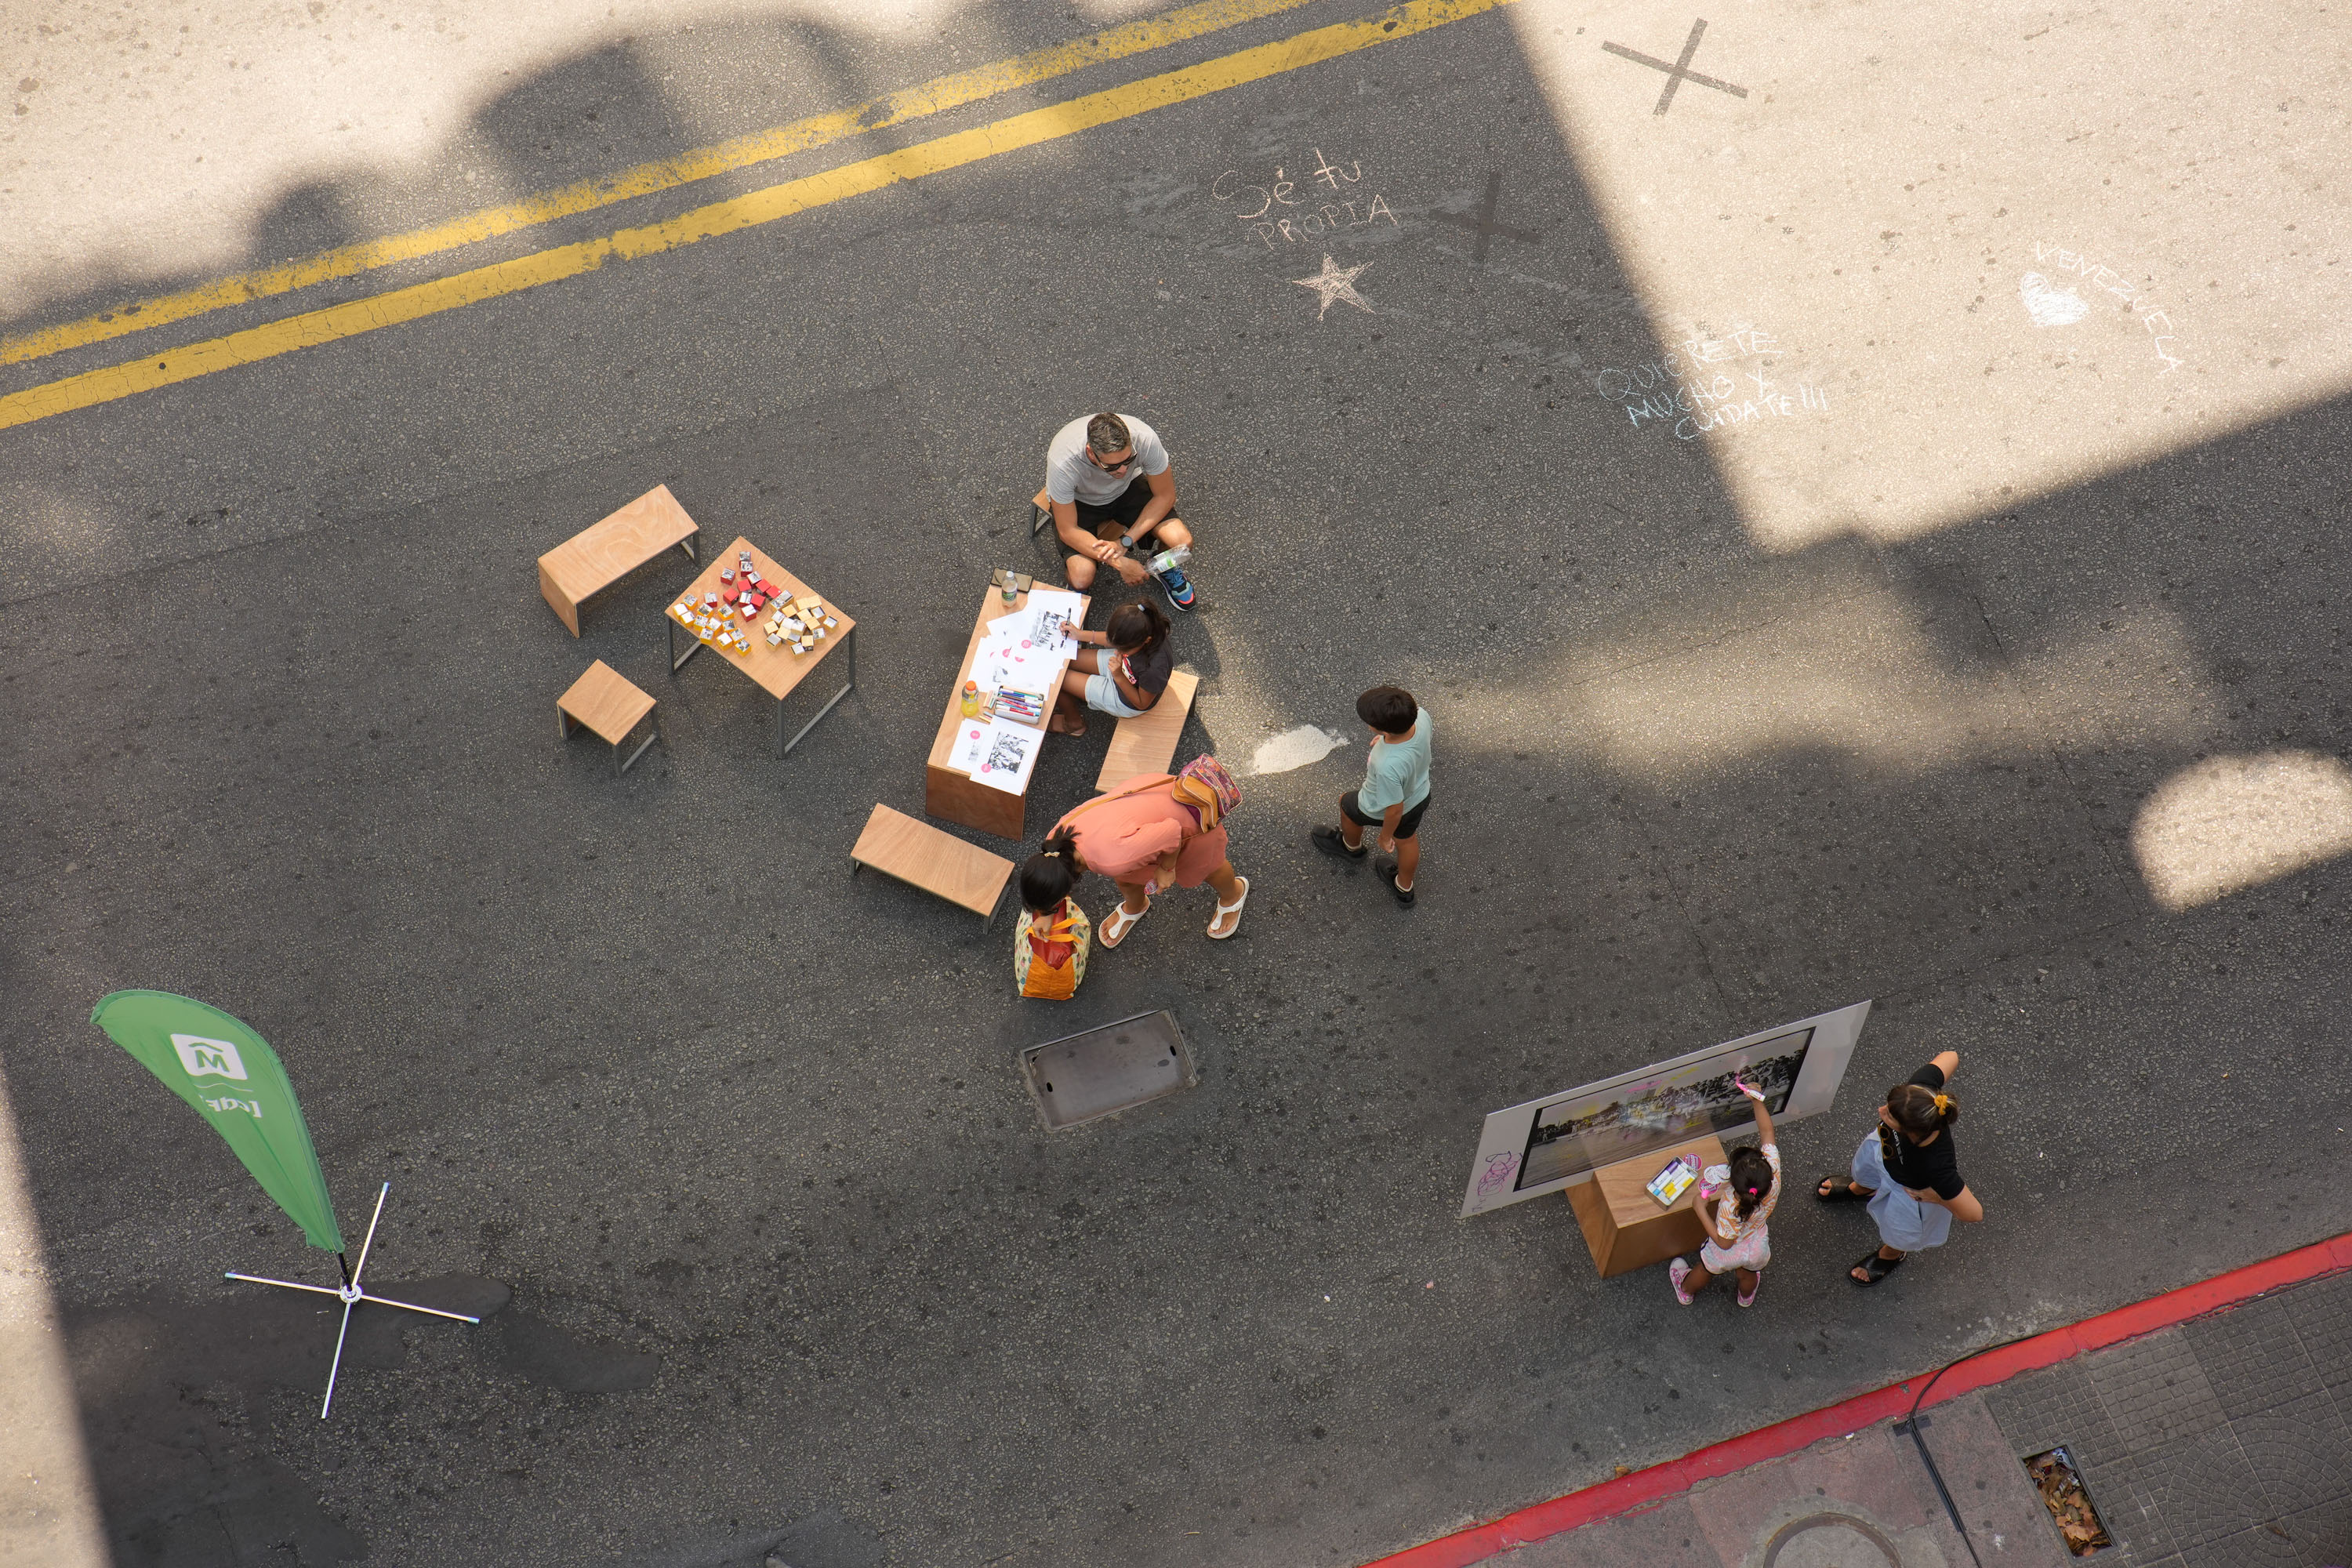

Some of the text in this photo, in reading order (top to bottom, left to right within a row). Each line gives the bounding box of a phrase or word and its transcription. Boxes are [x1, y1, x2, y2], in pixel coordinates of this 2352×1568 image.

[1213, 147, 1361, 220] Sé tu
[1245, 194, 1398, 251] PROPIA
[2036, 240, 2186, 375] VENEZUELA
[1627, 368, 1774, 428] MUCHO Y
